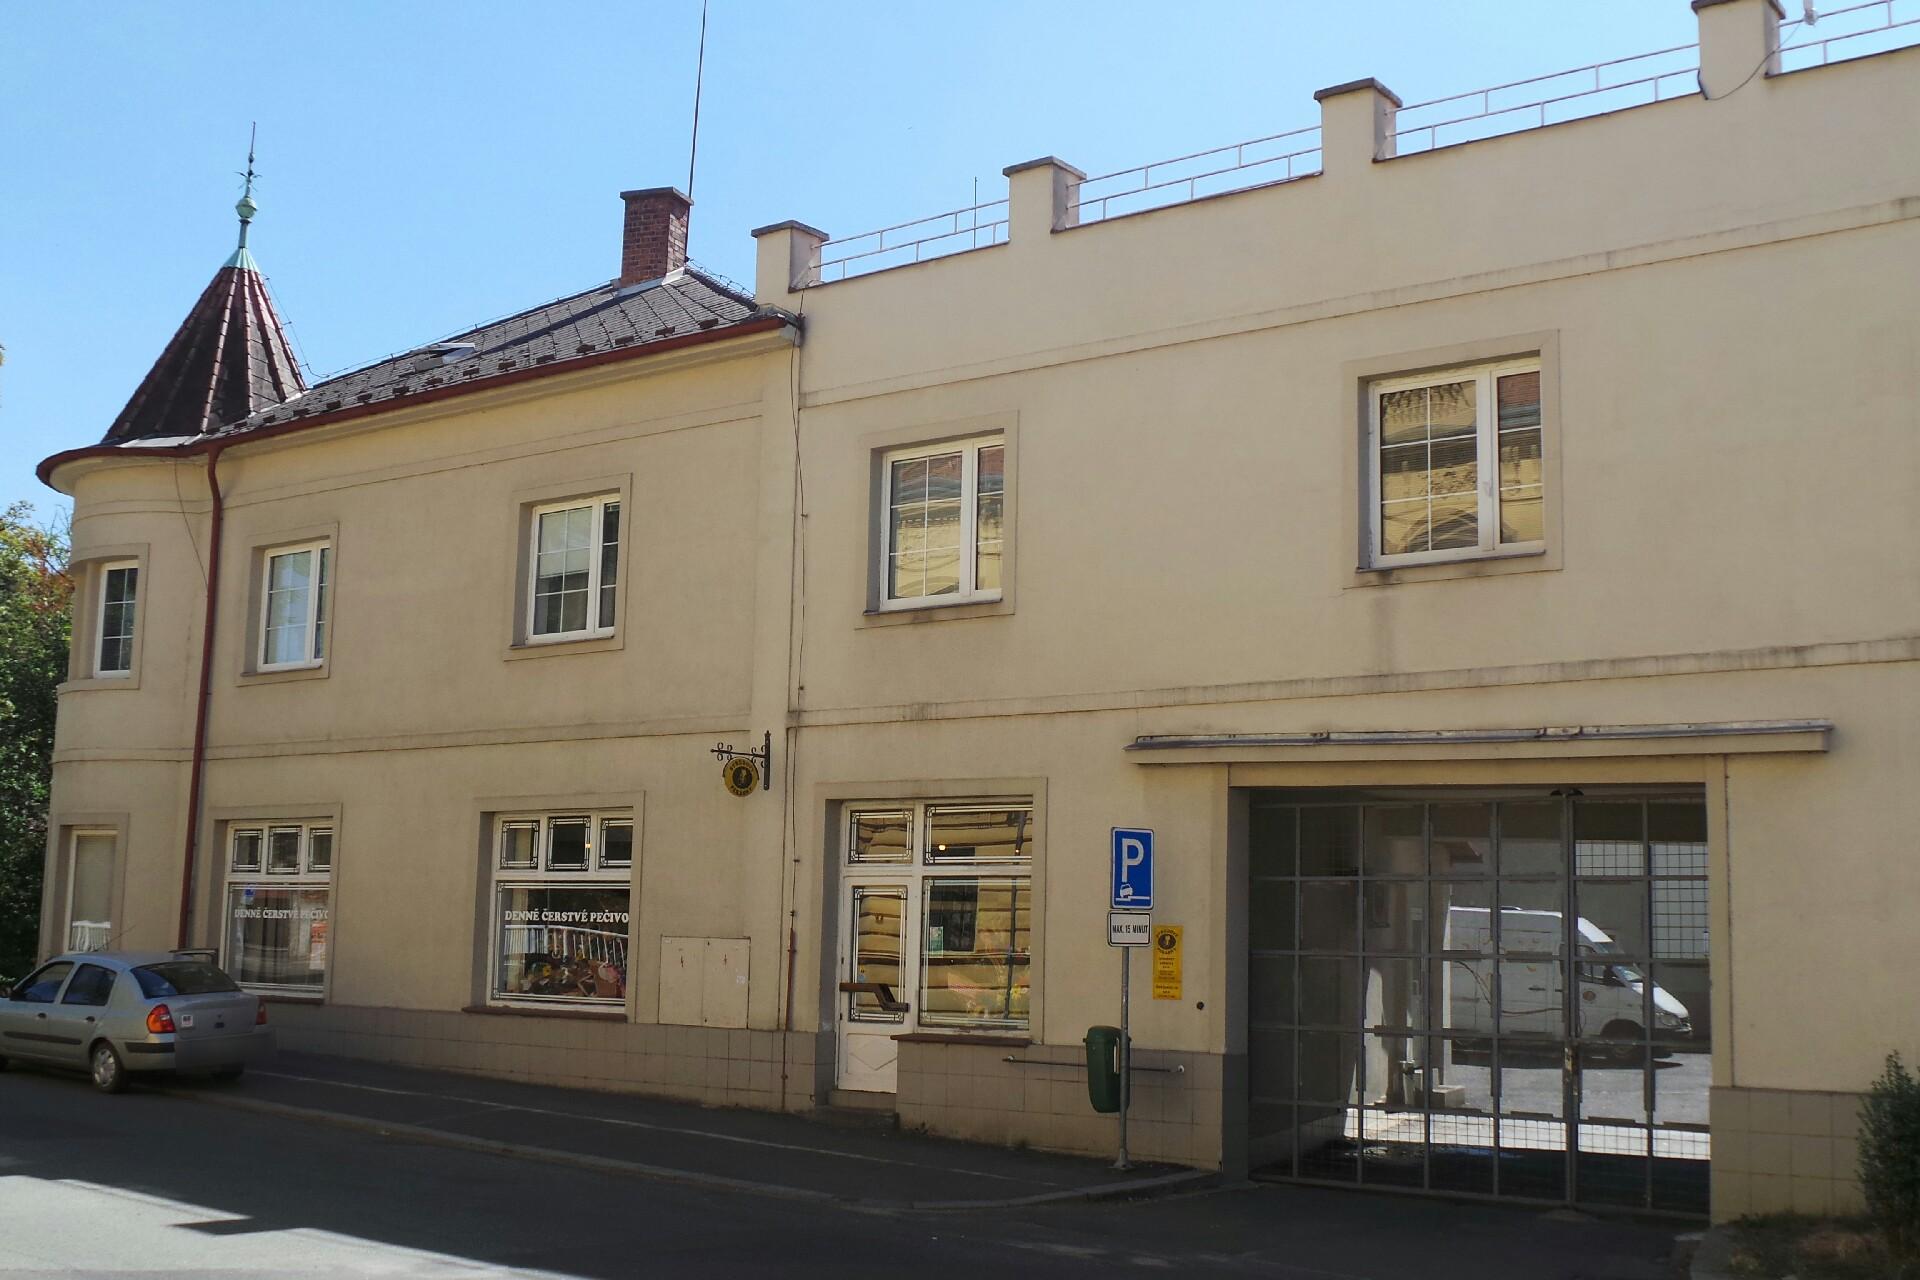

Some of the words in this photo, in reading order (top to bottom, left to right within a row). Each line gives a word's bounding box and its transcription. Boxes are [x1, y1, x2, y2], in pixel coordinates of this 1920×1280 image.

[1122, 838, 1144, 882] P
[263, 903, 299, 919] ČERSTVÉ
[541, 908, 588, 922] ČERSTVÉ
[589, 910, 629, 923] PEČIVO
[1125, 924, 1131, 934] 15
[1132, 924, 1148, 934] MINUT
